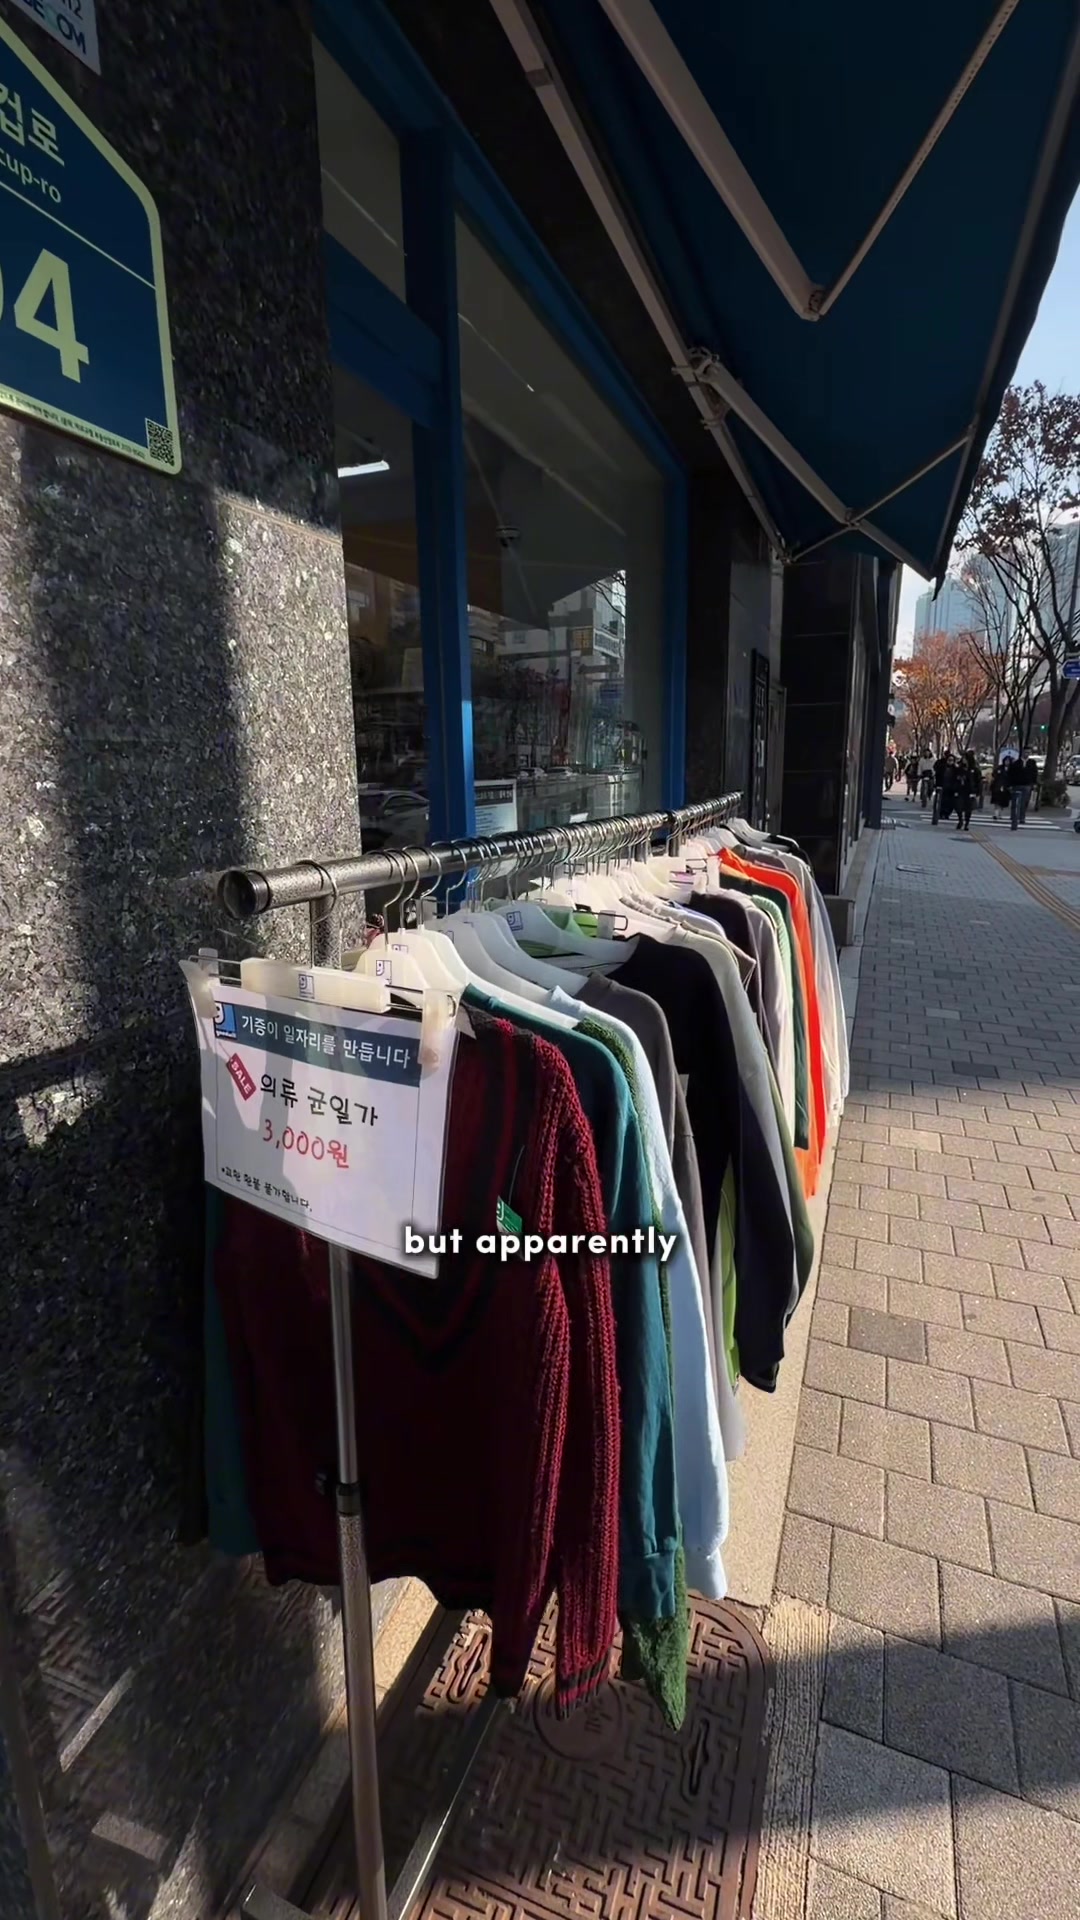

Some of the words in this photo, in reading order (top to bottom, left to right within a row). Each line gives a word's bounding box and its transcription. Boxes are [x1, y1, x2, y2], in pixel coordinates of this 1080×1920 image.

[0, 248, 90, 384] 4
[241, 1015, 279, 1040] 기증이
[283, 1024, 336, 1056] 일자리를
[343, 1039, 411, 1070] 만듭니다
[231, 1061, 253, 1095] SALE
[260, 1073, 298, 1108] 의류
[307, 1086, 379, 1126] 균일가
[262, 1118, 349, 1169] 3,000원
